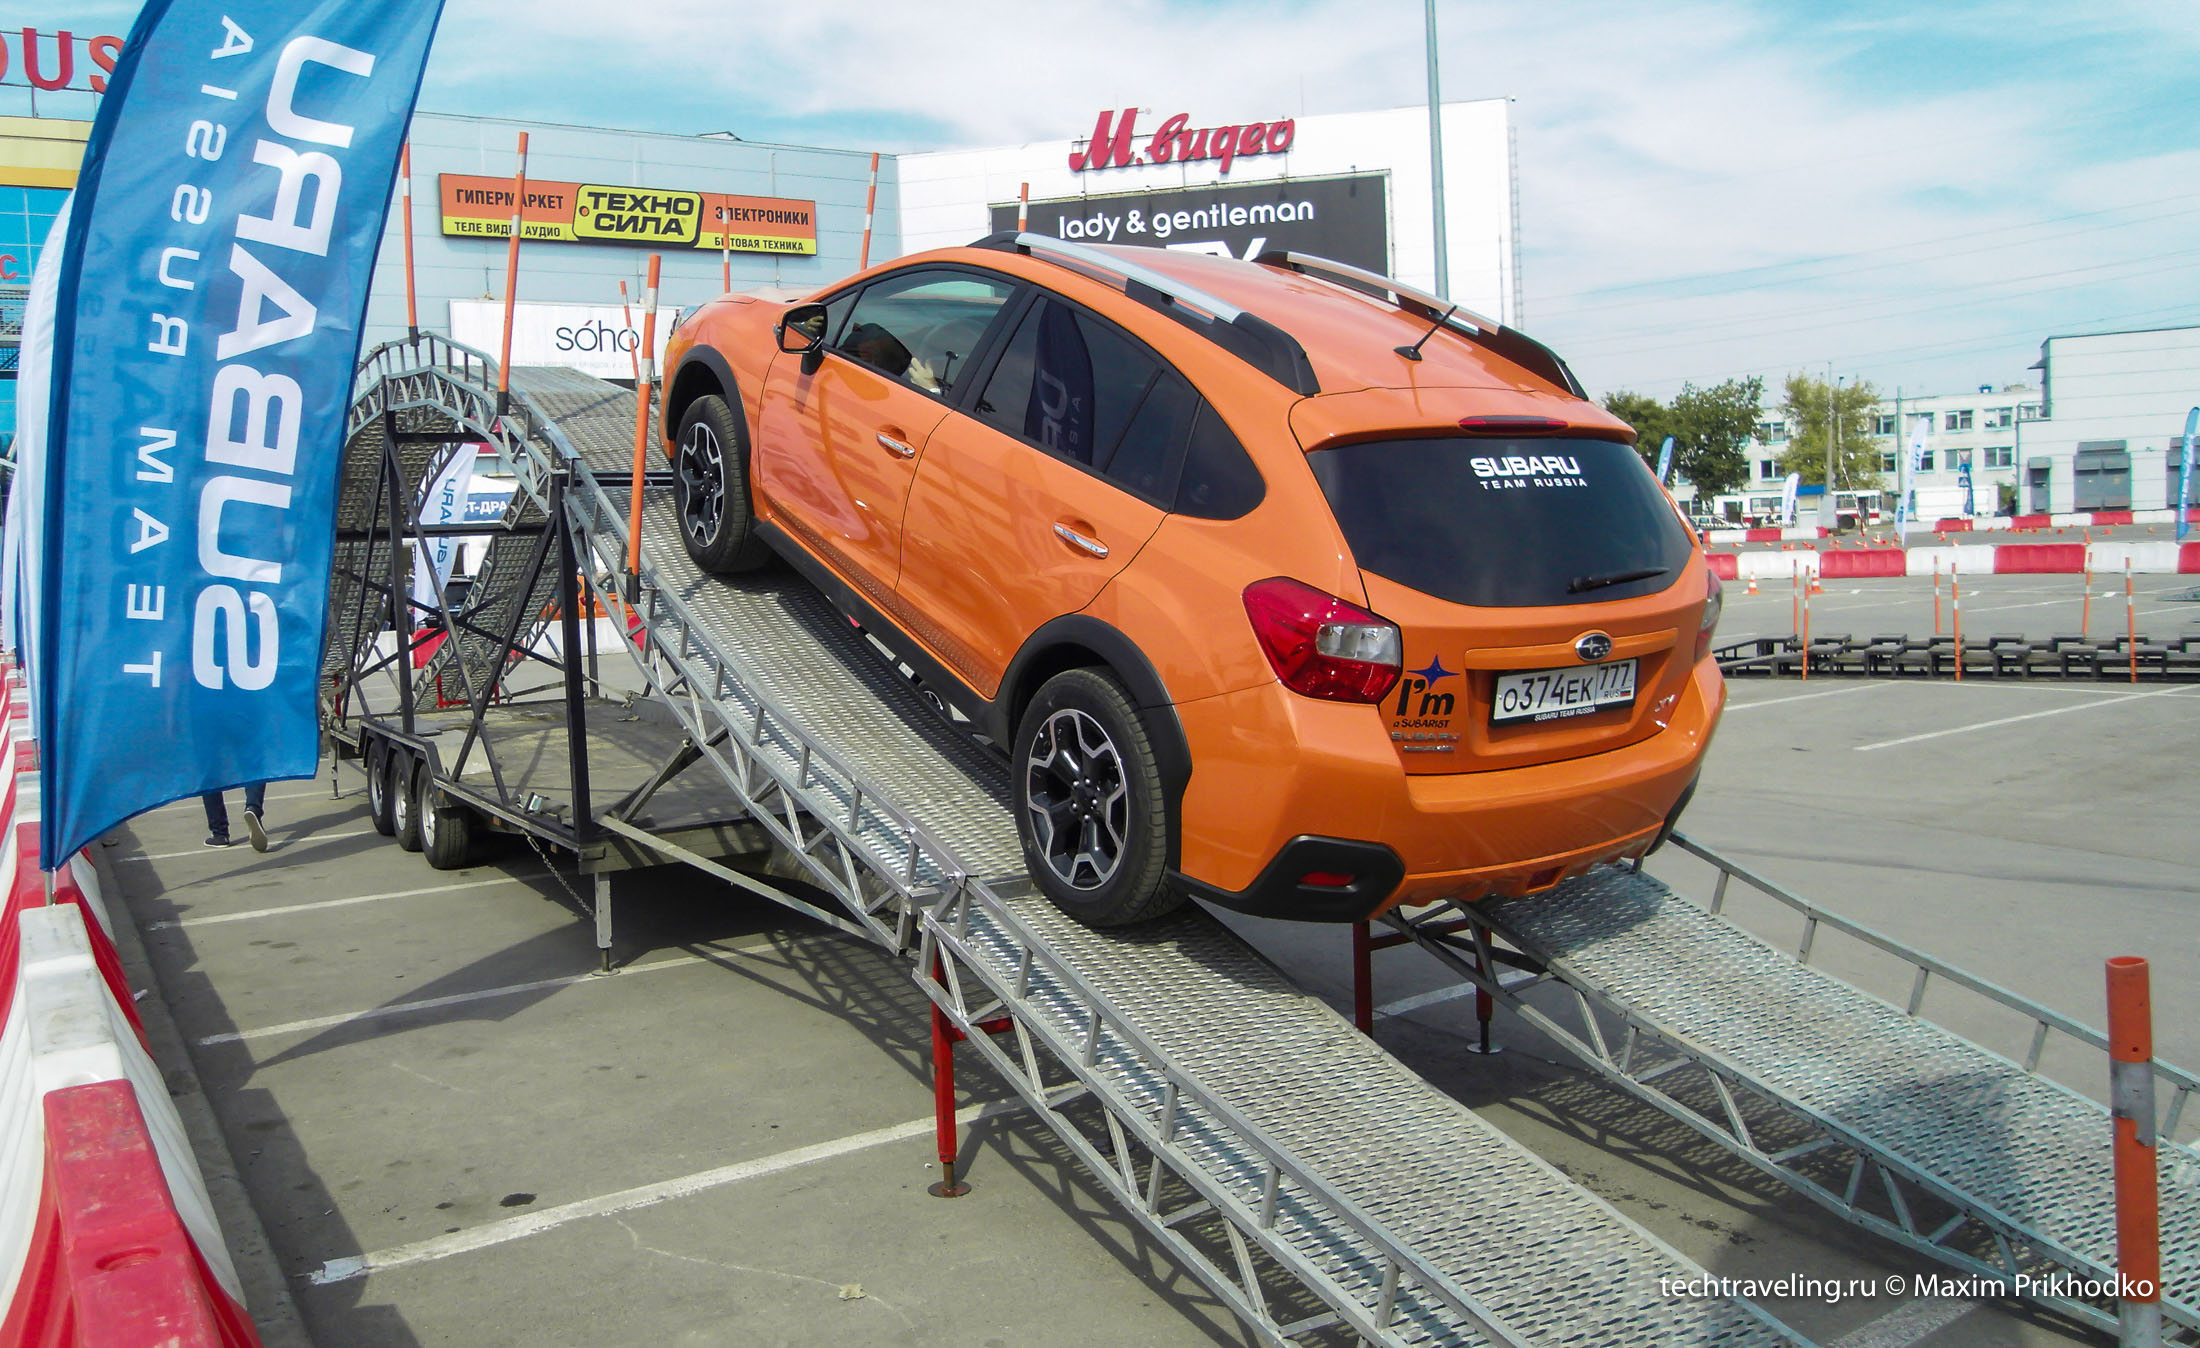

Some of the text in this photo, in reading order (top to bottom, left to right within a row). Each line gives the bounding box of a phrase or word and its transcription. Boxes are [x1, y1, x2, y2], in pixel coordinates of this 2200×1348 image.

[0, 27, 125, 94] US
[587, 192, 694, 215] ТЕХНО
[454, 221, 560, 237] ТЕЛЕ ВИД АУДИО
[594, 213, 684, 236] СИЛА
[1059, 201, 1314, 241] lady & gentleman
[763, 240, 804, 251] ТЕХНИКА
[1470, 456, 1580, 477] SUBARU
[1480, 478, 1588, 489] TEAM RUSSIA
[1600, 663, 1629, 691] 777
[1604, 688, 1620, 698] RUS
[1534, 706, 1596, 722] SUBARU TEAM RUSSIA
